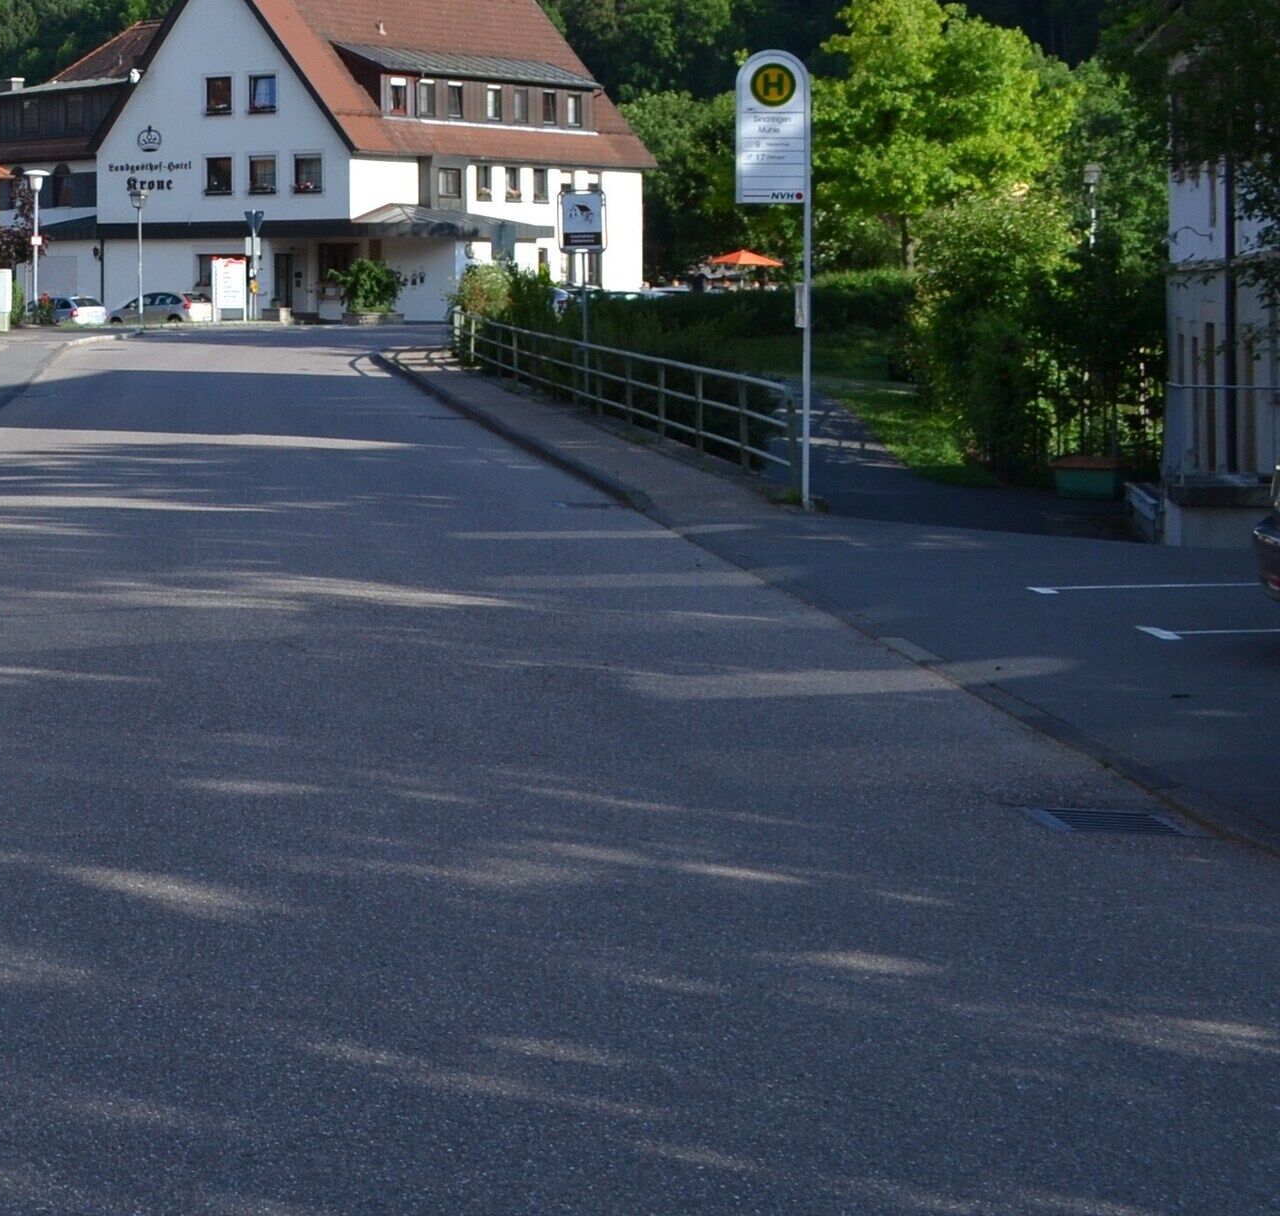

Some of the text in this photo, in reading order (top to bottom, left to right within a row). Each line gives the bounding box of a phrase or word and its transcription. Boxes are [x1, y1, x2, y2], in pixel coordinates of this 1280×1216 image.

[763, 73, 784, 96] H
[108, 160, 192, 174] Landgasthof-Hotel
[126, 176, 174, 192] Krone
[770, 192, 795, 200] NVH
